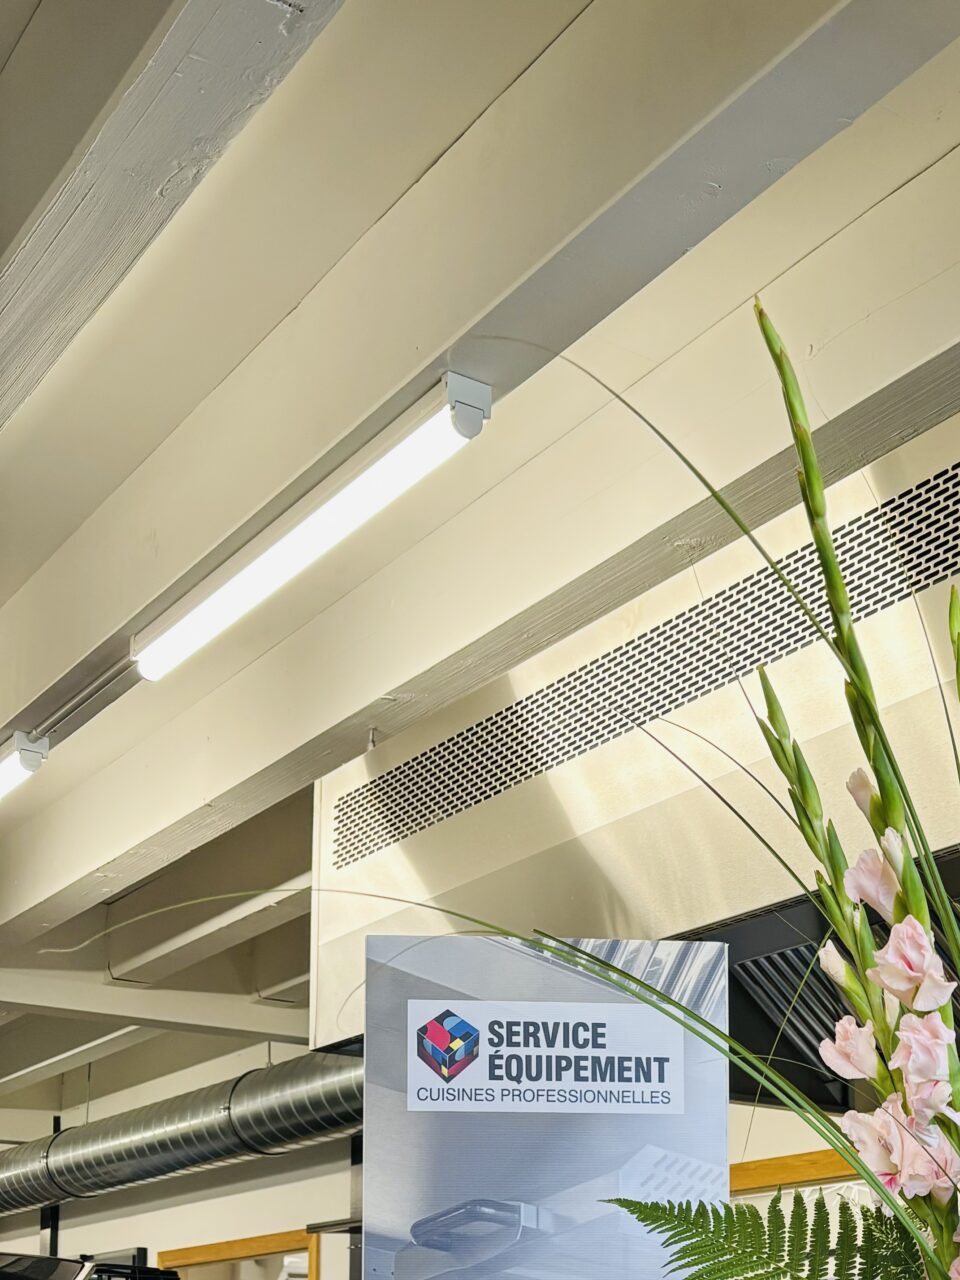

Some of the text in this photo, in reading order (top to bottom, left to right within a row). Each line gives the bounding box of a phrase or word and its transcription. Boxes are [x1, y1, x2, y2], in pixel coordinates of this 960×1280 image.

[488, 1020, 607, 1049] SERVICE
[488, 1051, 670, 1084] ÉQUIPEMENT
[417, 1087, 671, 1105] CUISINES PROFESSIONNELLES
